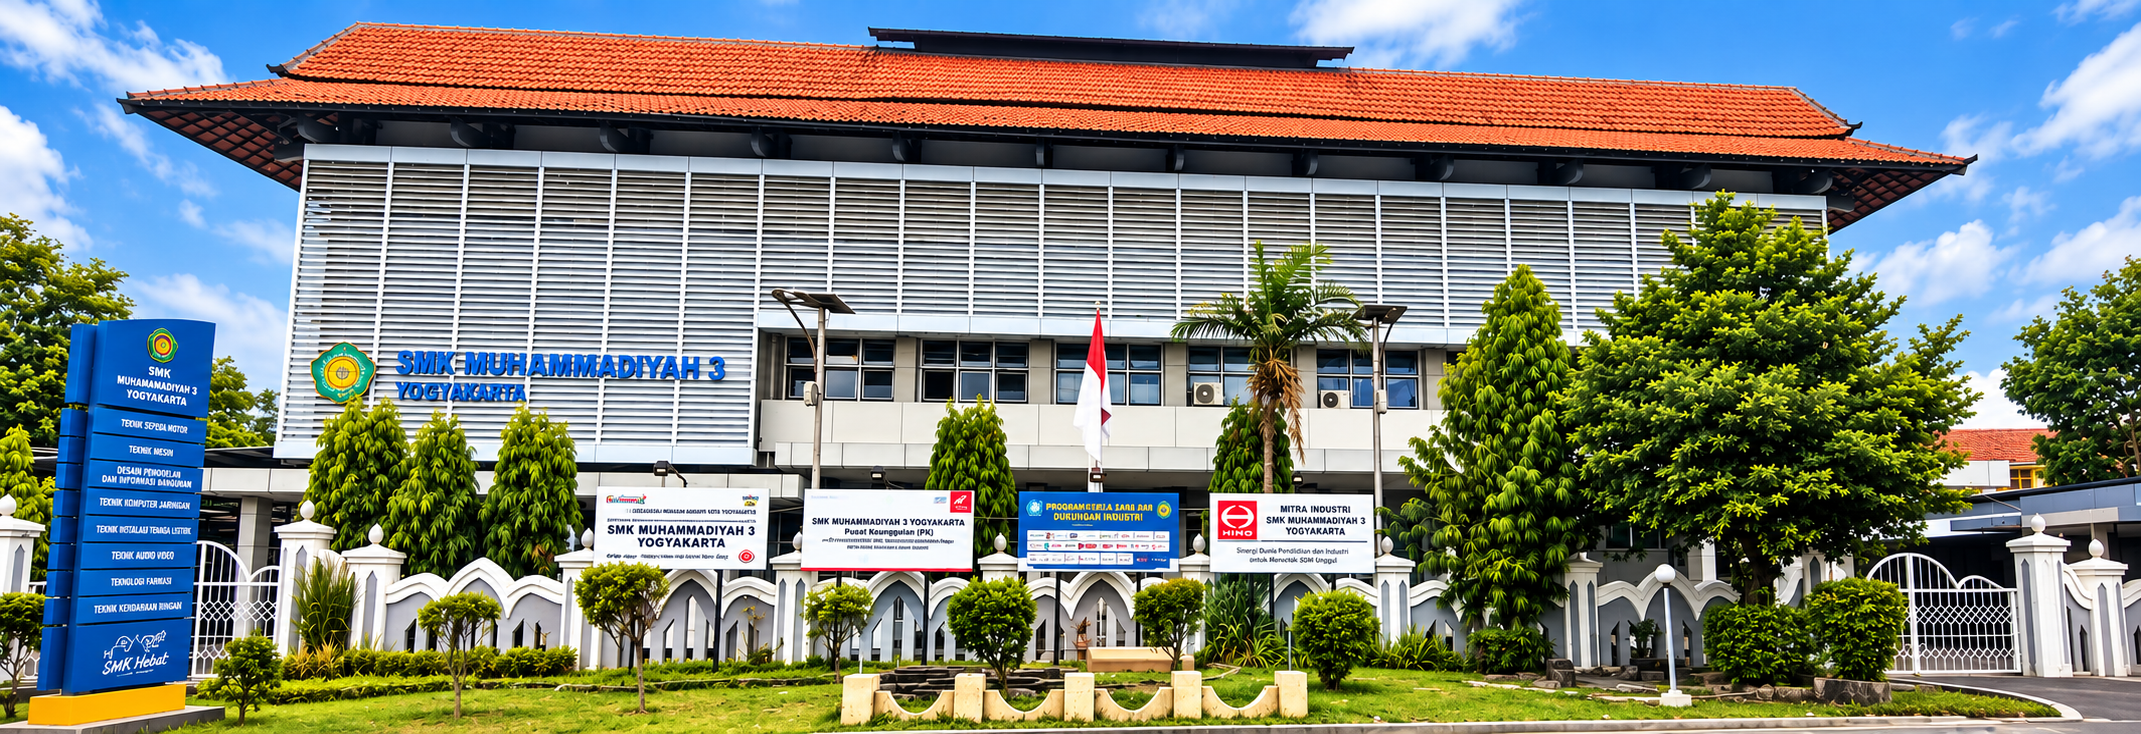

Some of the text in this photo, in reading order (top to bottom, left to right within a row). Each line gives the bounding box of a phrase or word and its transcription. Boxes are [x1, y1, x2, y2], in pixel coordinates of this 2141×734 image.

[395, 350, 726, 381] SMK MUHAMMADIYAH 3
[149, 366, 171, 378] SMK
[192, 386, 198, 396] 3
[396, 382, 526, 402] YOGYAKARTA
[127, 389, 187, 406] YOGYAKARTA
[1280, 505, 1307, 513] MITRA
[832, 518, 900, 526] MUHAMMADIYAH
[1266, 516, 1285, 524] SMK
[607, 525, 755, 536] SMK MUHAMMADIYAH 3
[1286, 527, 1345, 535] YOGYAKARTA
[638, 537, 726, 548] YOGYAKARTA
[102, 656, 134, 675] SMK
[134, 652, 169, 669] Hebat
